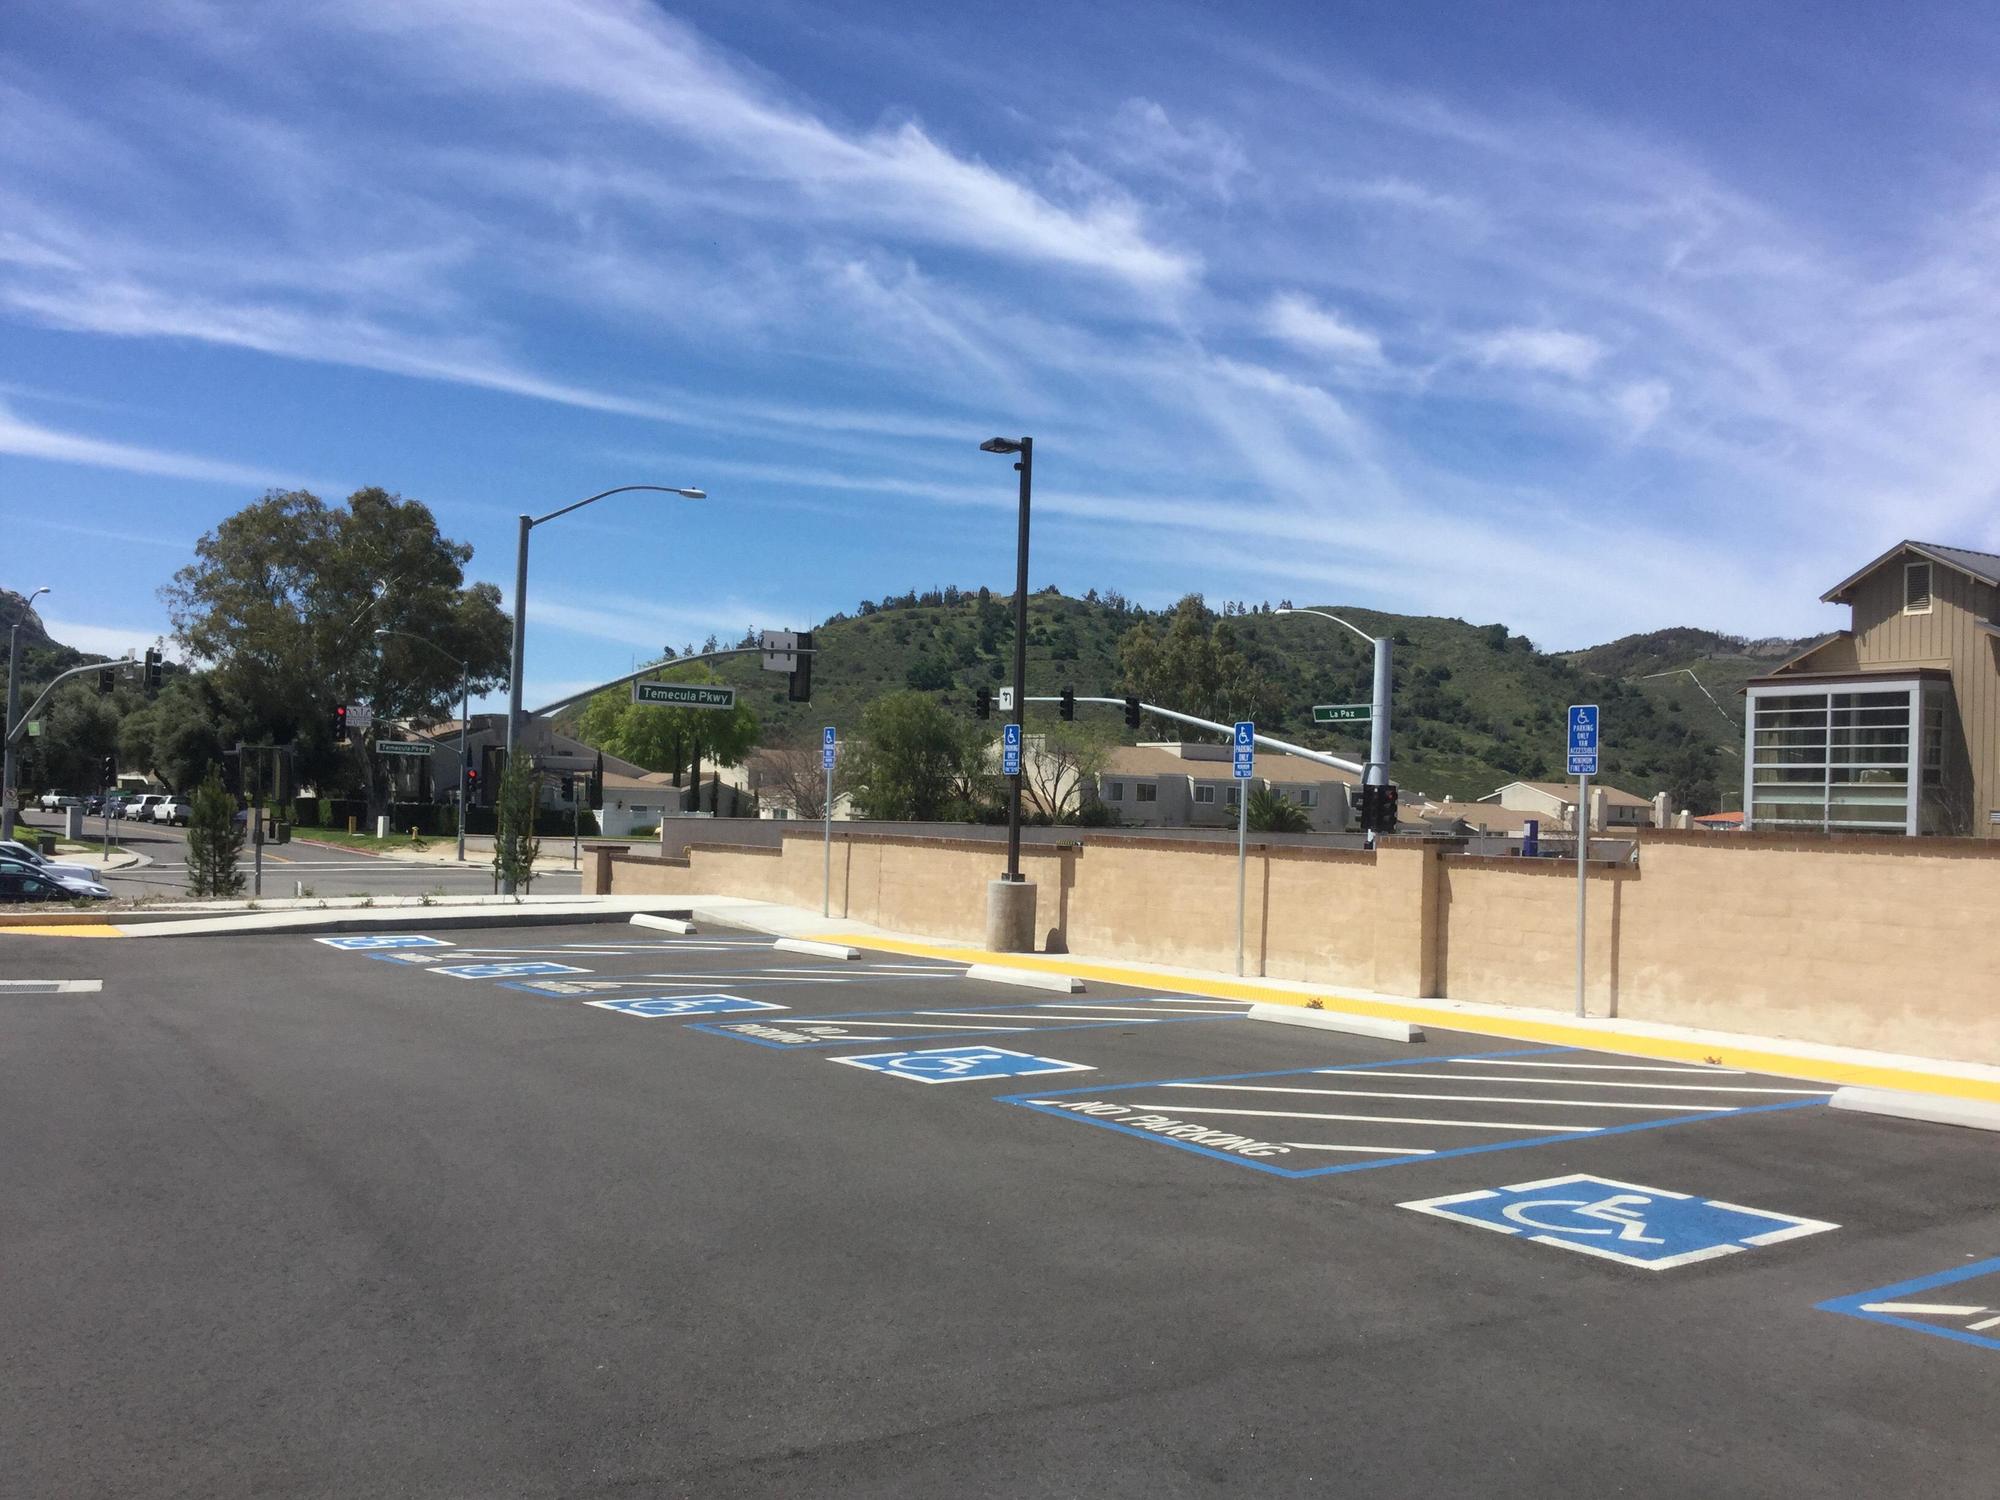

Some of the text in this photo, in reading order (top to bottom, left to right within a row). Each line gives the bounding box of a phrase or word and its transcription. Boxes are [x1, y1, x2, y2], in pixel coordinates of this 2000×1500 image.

[643, 687, 729, 705] Temecula Pkwy
[1329, 710, 1355, 718] La Paz
[1573, 724, 1594, 732] PARKING
[1576, 732, 1590, 740] ONLY
[1059, 1101, 1291, 1156] NO PARKING
